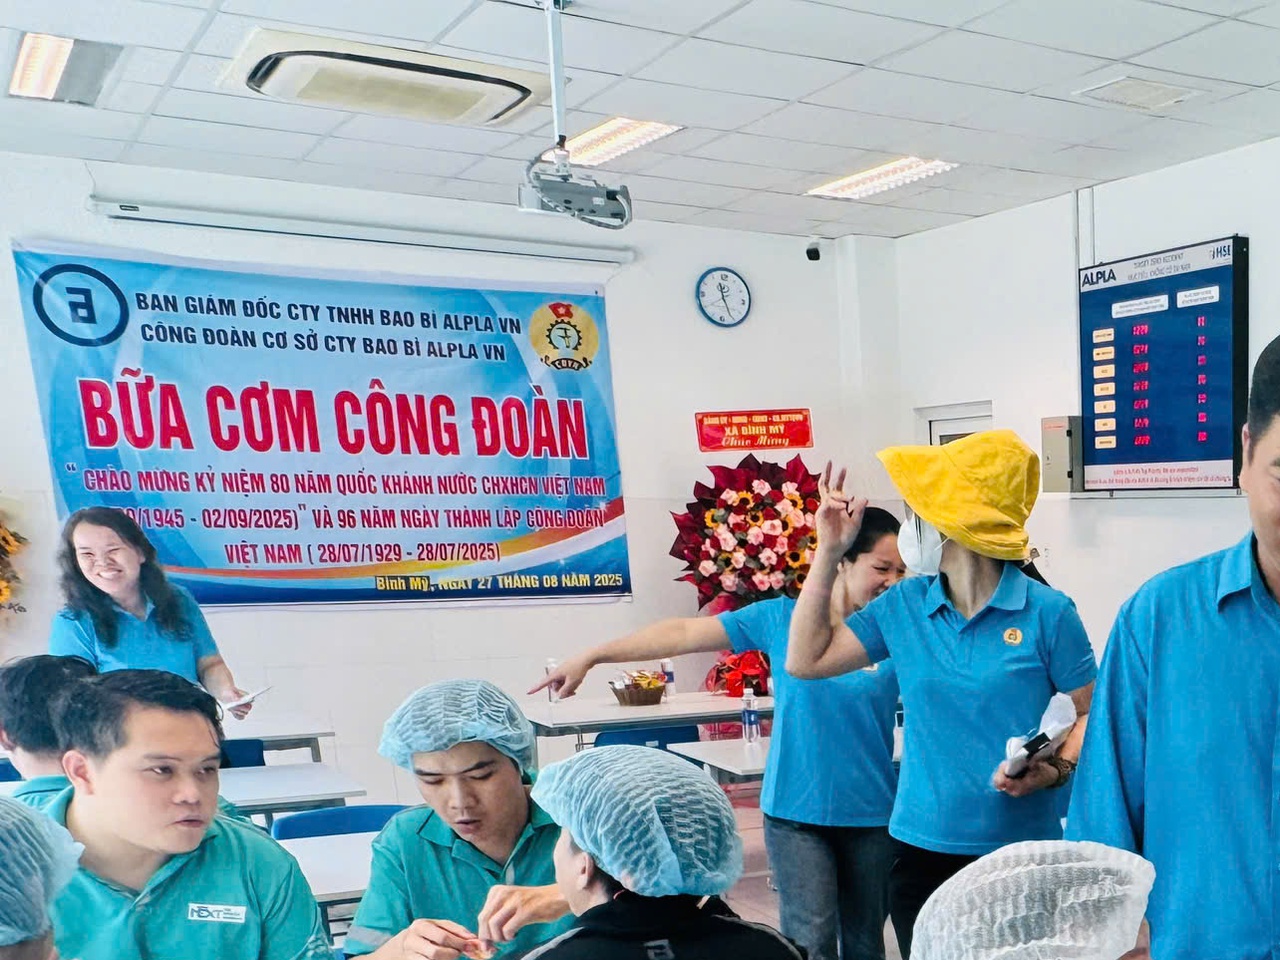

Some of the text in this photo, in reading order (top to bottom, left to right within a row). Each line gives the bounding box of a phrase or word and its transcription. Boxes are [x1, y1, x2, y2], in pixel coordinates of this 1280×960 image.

[1082, 269, 1116, 287] ALPLA
[135, 292, 522, 334] BAN GIÁM ĐỐC CTY TNHH BAO BÌ ALPLA VN
[140, 321, 506, 362] CÔNG ĐOÀN CƠ SỞ CTY BAO BÌ ALPLA VN
[77, 367, 589, 459] BỮA CƠM CÔNG ĐOÀN
[84, 467, 132, 493] CHÀO
[137, 467, 191, 493] MỪNG
[221, 470, 267, 499] NIỆM
[270, 473, 291, 493] 80
[294, 470, 332, 494] NĂM
[336, 468, 378, 496] QUỐC
[382, 471, 434, 495] KHÁNH
[437, 471, 477, 496] NƯỚC
[481, 475, 538, 497] CHXHCN
[541, 473, 571, 500] VIỆT
[573, 477, 606, 497] NAM
[312, 506, 333, 528] VÀ
[337, 509, 356, 528] 96
[360, 506, 396, 528] NĂM
[400, 505, 440, 528] NGÀY
[444, 505, 492, 528] THÀNH
[496, 508, 521, 532] LẬP
[526, 506, 563, 528] CÔNG
[564, 507, 605, 528] ĐOÀN
[224, 541, 258, 568] VIỆT
[263, 543, 302, 564] NAM
[317, 543, 401, 564] 28/07/1929
[416, 542, 501, 562] 28/07/2025)
[477, 579, 492, 590] 27
[543, 575, 558, 588] 08
[594, 574, 623, 587] 2025
